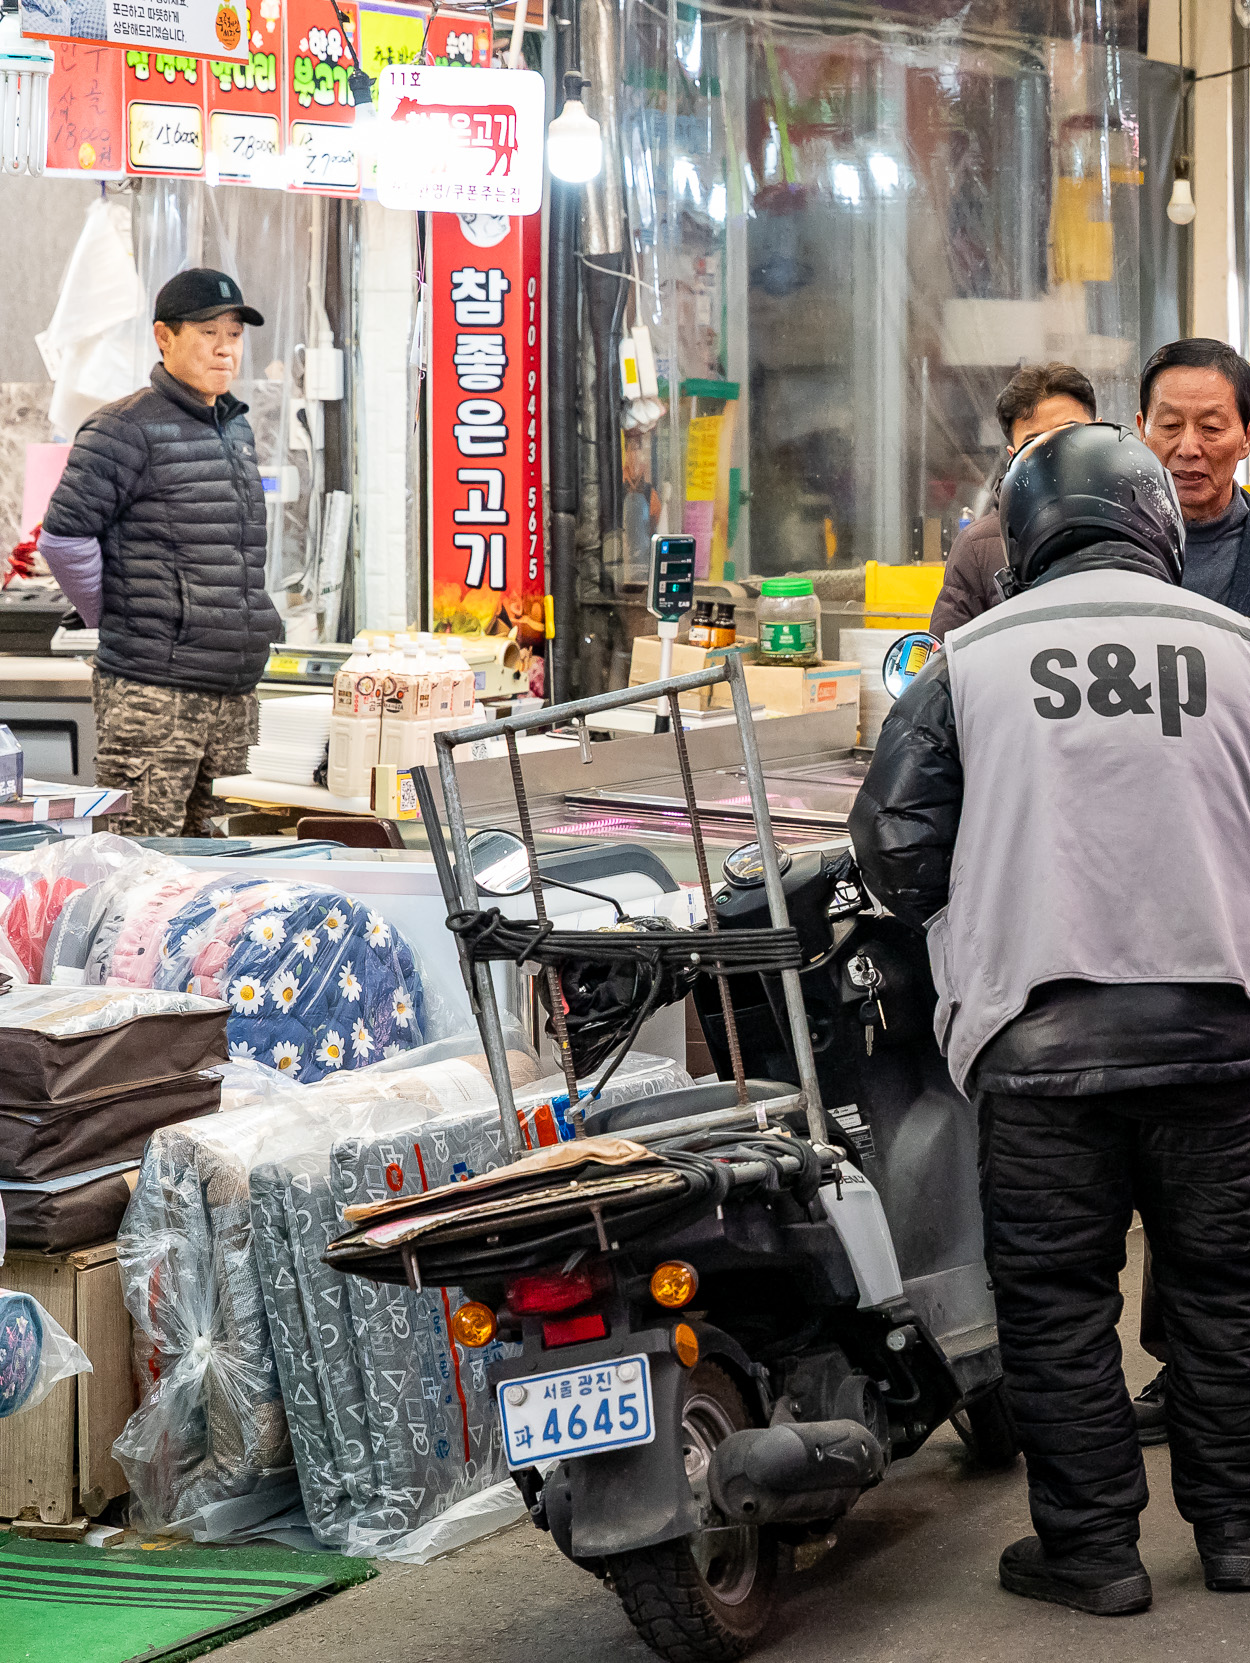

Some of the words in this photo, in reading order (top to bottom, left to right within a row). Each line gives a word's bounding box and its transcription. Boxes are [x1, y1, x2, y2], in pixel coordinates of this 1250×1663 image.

[112, 3, 145, 18] 포근하고
[147, 8, 180, 24] 따뜻하게
[113, 23, 187, 43] 상담해드리겠습니다.
[308, 27, 343, 62] 한우
[293, 55, 357, 109] 불고기
[390, 71, 421, 87] 11호
[451, 266, 511, 590] 참좋은고기
[1030, 643, 1207, 737] s&p
[543, 1380, 573, 1400] 서울
[578, 1372, 612, 1396] 광진
[514, 1425, 534, 1449] 파
[542, 1393, 639, 1445] 4645
